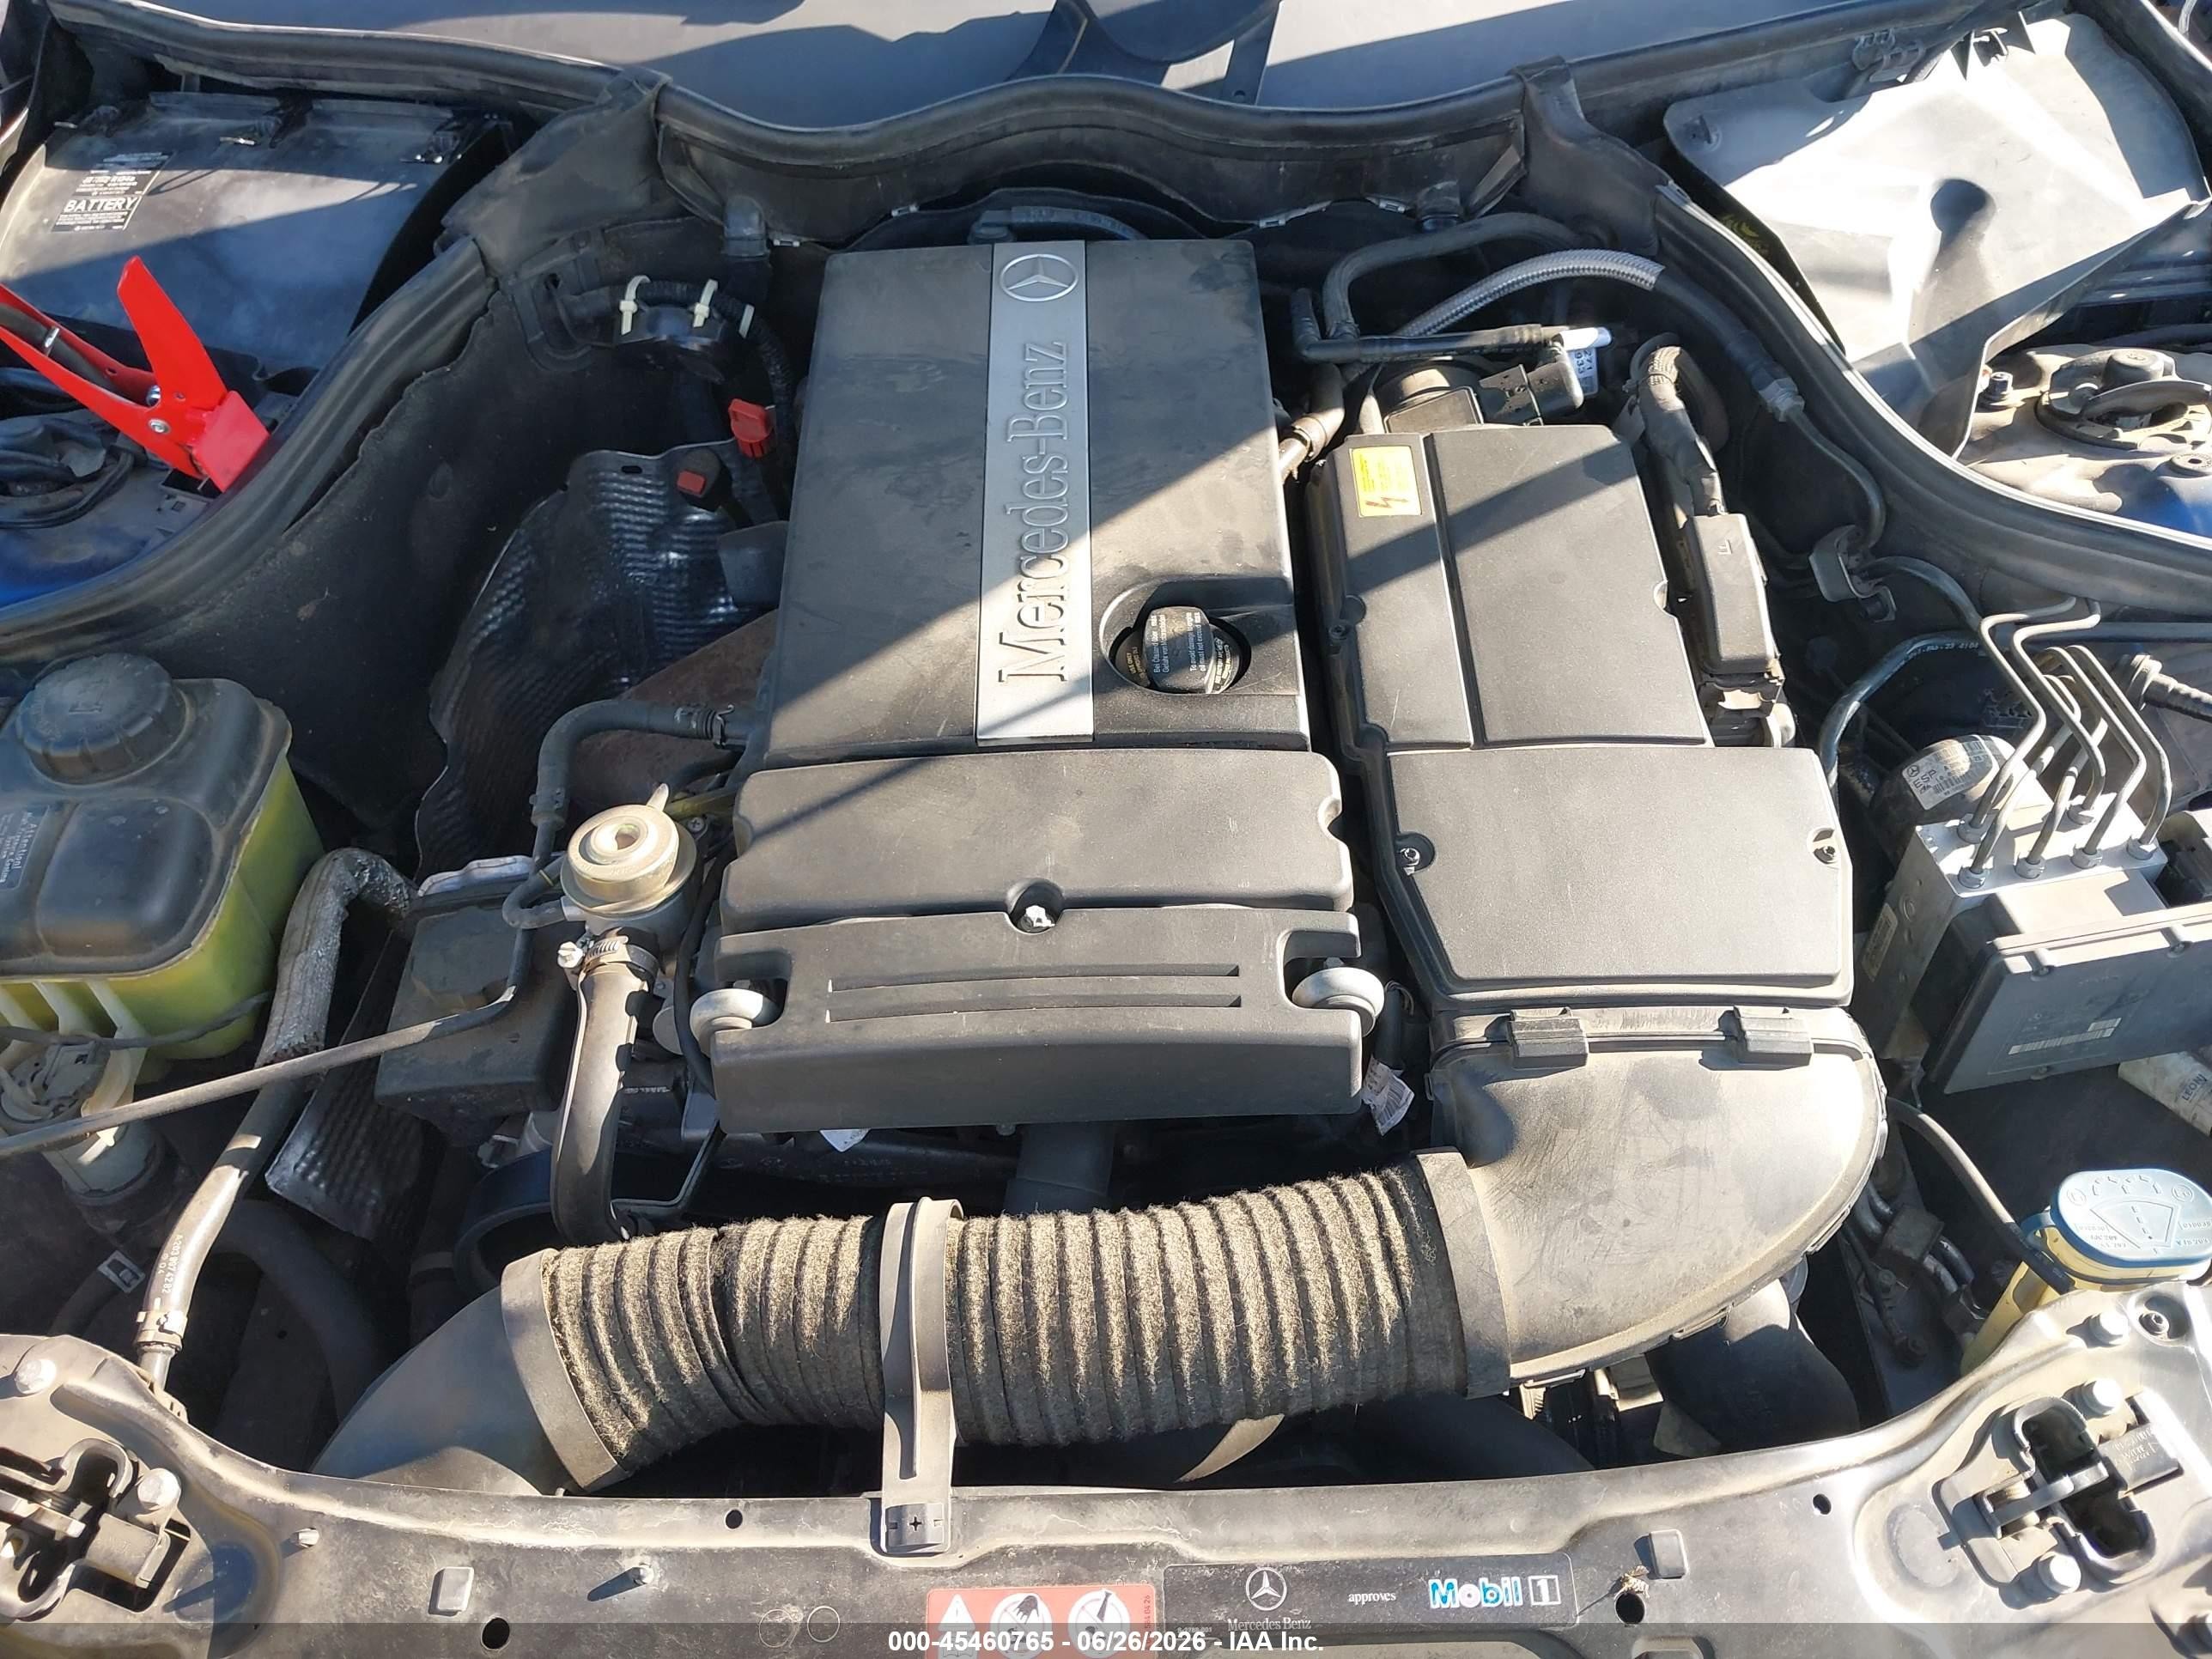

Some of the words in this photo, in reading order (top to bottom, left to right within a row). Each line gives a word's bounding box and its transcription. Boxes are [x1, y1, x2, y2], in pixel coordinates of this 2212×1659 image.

[63, 198, 138, 213] BATTERY
[997, 340, 1068, 684] Mercedes-Benz
[1913, 769, 1936, 788] ESP
[1347, 1590, 1396, 1605] approves
[1428, 1576, 1523, 1608] Mobil
[1228, 1618, 1281, 1631] Mercedes
[1283, 1617, 1312, 1630] Benz
